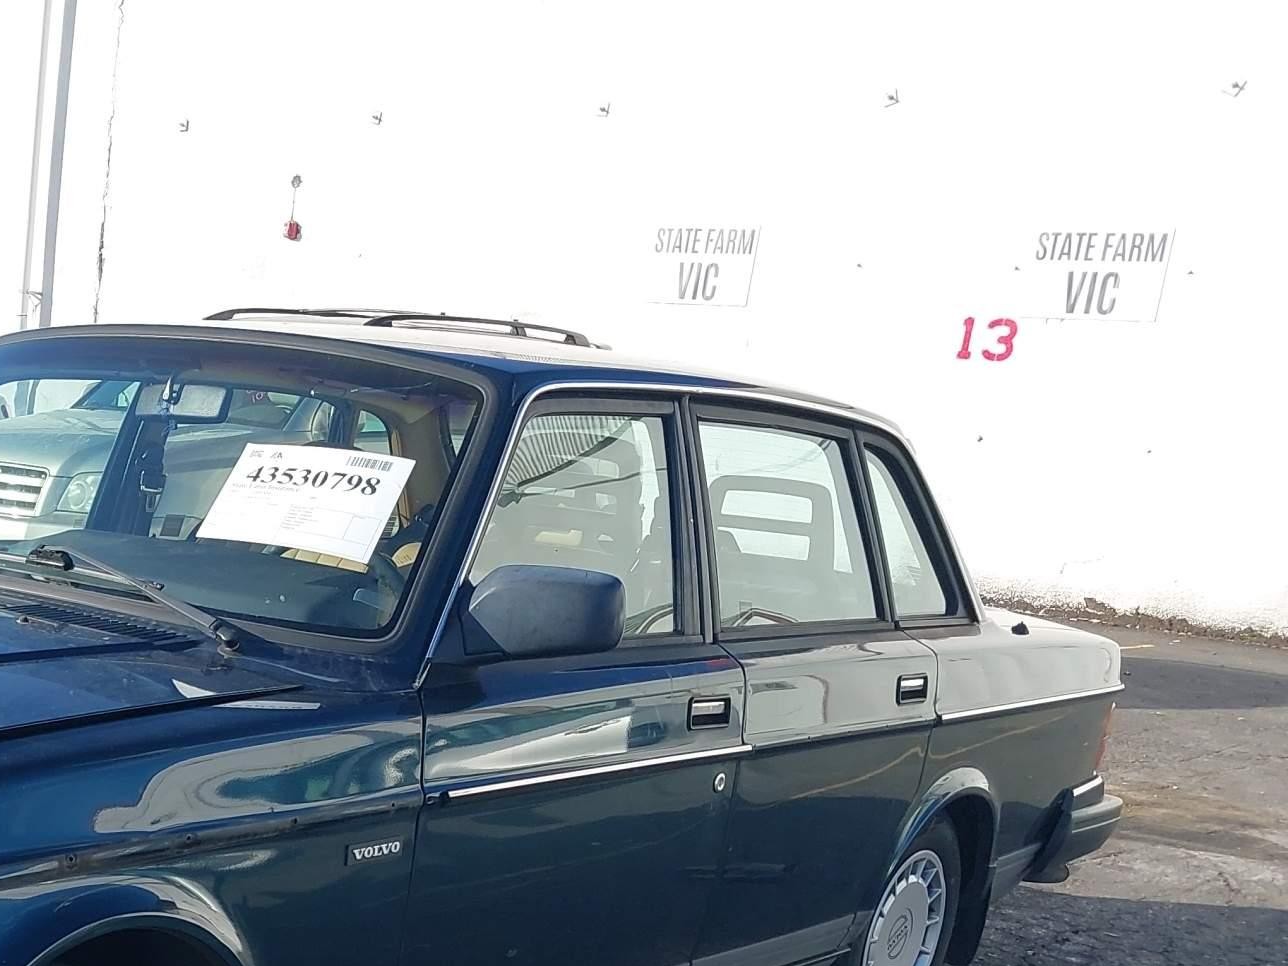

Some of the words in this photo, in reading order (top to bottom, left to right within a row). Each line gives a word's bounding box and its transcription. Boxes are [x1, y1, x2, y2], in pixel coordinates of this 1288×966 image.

[655, 227, 703, 254] STATE
[704, 228, 756, 255] FARM
[1035, 232, 1098, 261] STATE
[1101, 233, 1168, 263] FARM
[678, 262, 720, 301] VIC
[1065, 271, 1120, 315] VIC
[957, 316, 1017, 362] 13
[246, 465, 381, 496] 43530798
[352, 841, 401, 860] VOLVO
